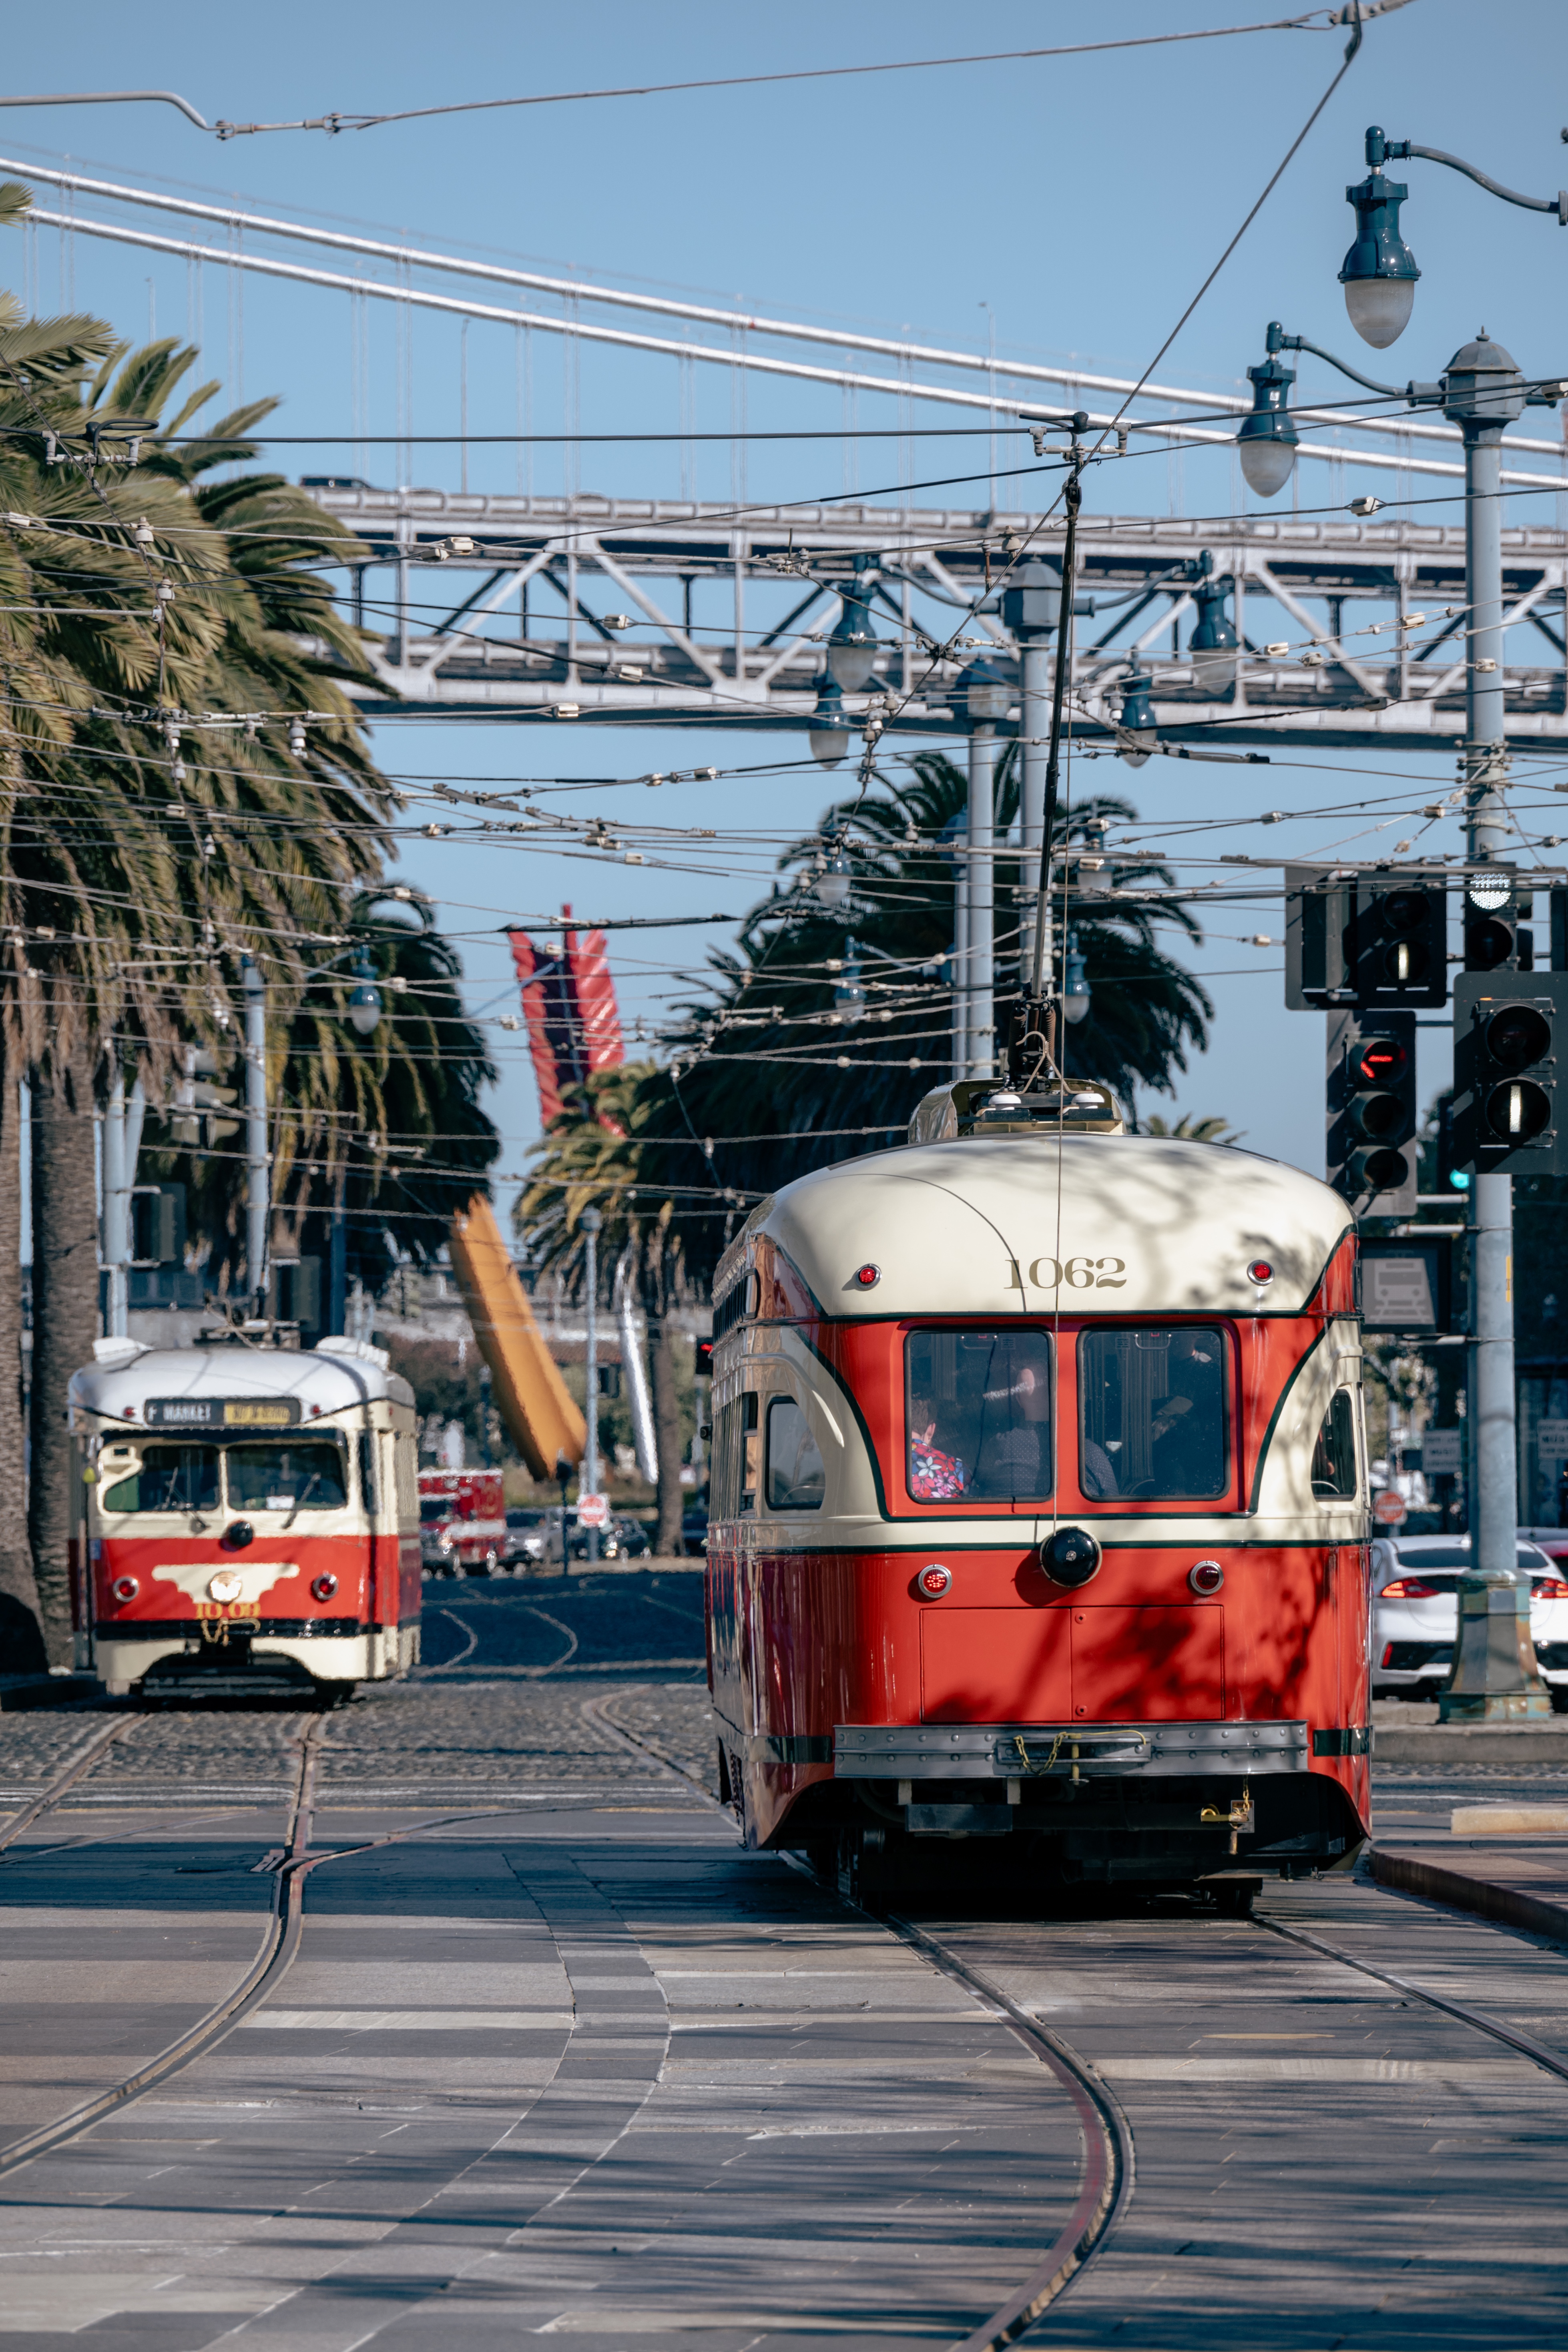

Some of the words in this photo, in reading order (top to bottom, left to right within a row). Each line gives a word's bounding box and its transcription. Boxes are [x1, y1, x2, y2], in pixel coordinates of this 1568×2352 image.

[1004, 1257, 1127, 1289] 1062
[148, 1404, 157, 1421] F
[163, 1404, 211, 1422] MARKET
